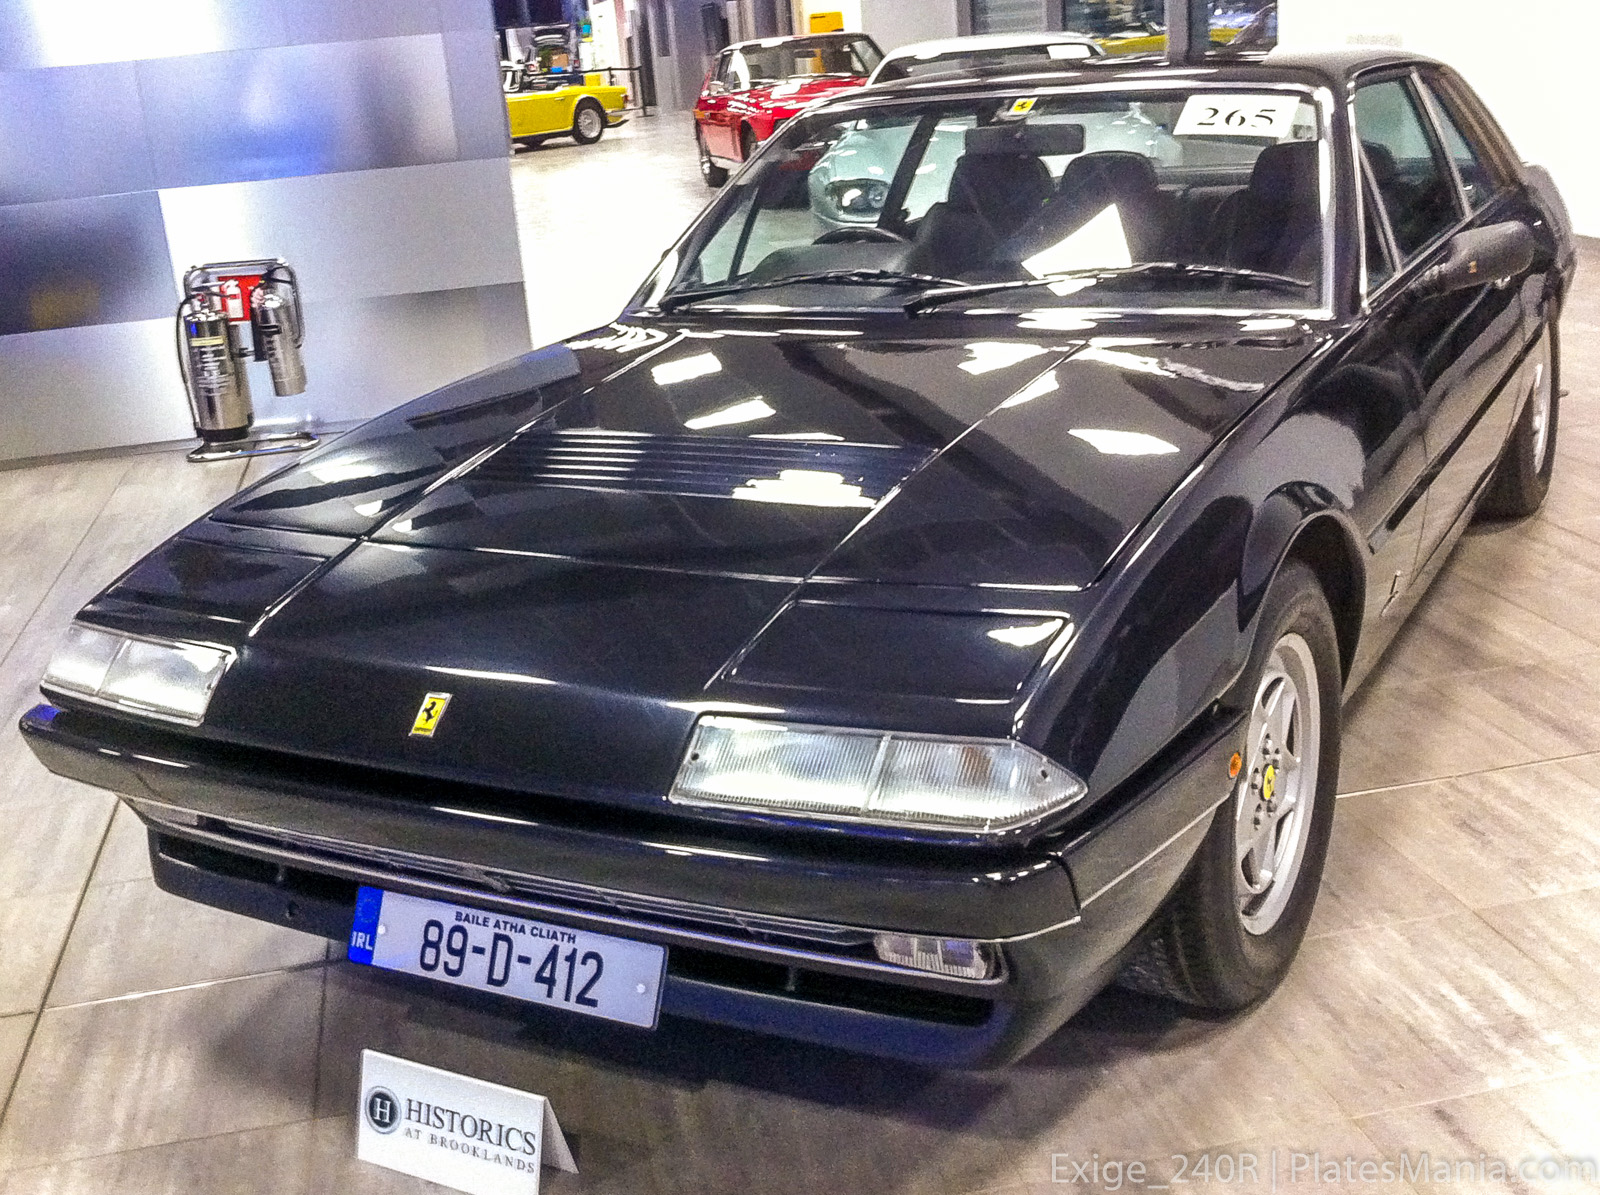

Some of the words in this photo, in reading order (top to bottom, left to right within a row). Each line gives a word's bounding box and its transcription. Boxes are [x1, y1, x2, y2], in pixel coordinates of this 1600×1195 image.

[1196, 107, 1277, 128] 265
[351, 930, 374, 951] IRL
[454, 910, 490, 929] BAILE
[493, 919, 526, 936] ATHA
[530, 925, 577, 944] CLIATH
[419, 919, 604, 1008] 89-D-412
[373, 1098, 391, 1124] H
[405, 1098, 536, 1156] HISTORICS
[404, 1127, 422, 1140] AT
[429, 1133, 535, 1174] BROOKLANDS
